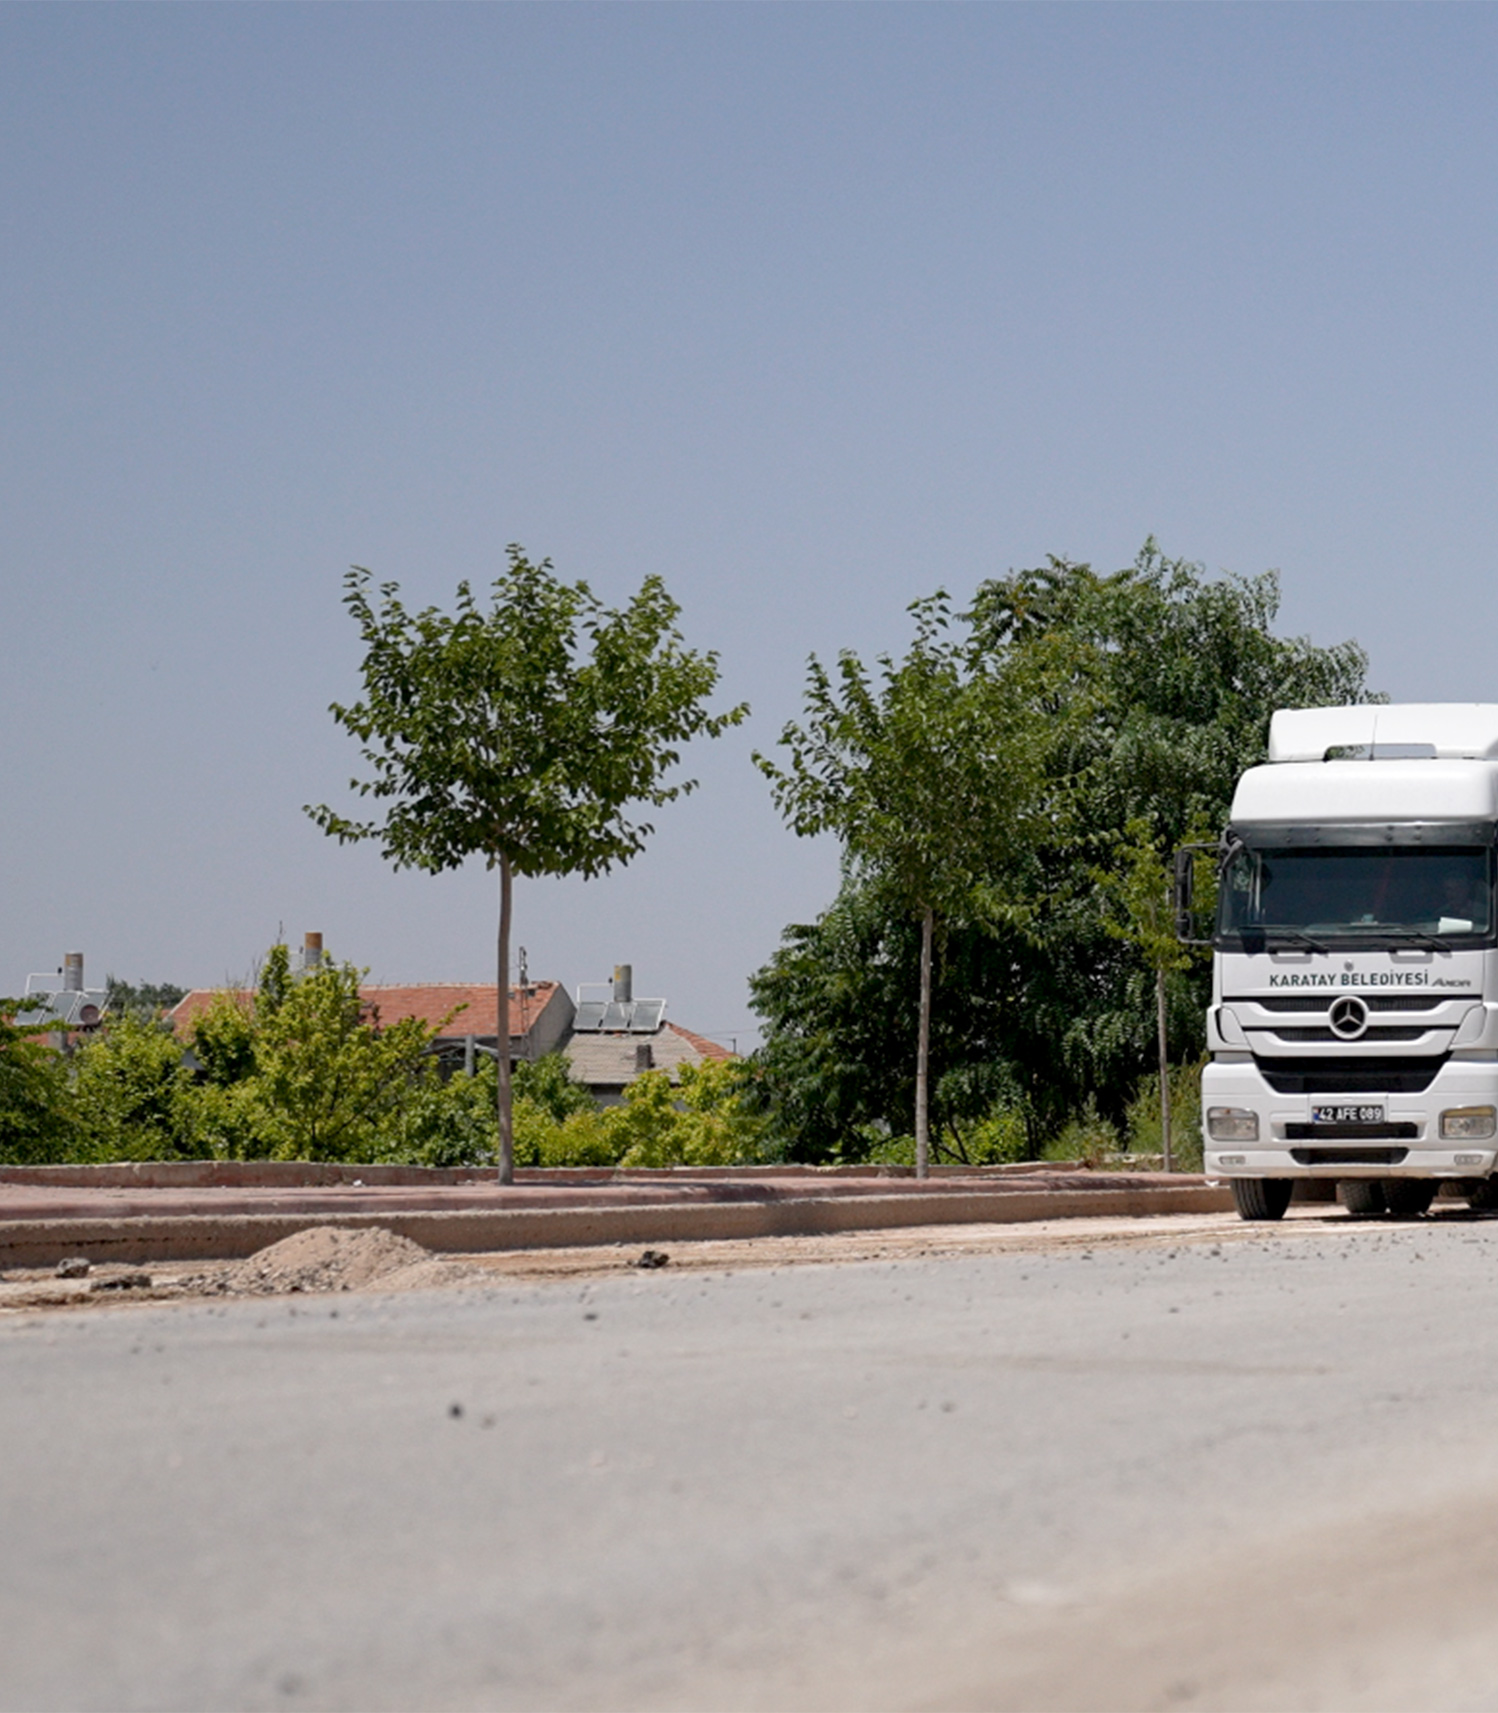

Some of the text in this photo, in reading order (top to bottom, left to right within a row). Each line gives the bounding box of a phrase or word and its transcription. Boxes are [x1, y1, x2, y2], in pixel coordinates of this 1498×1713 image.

[1269, 969, 1429, 987] KARATAY BELEDİYESİ
[1319, 1107, 1333, 1120] 42
[1336, 1107, 1357, 1120] AFE
